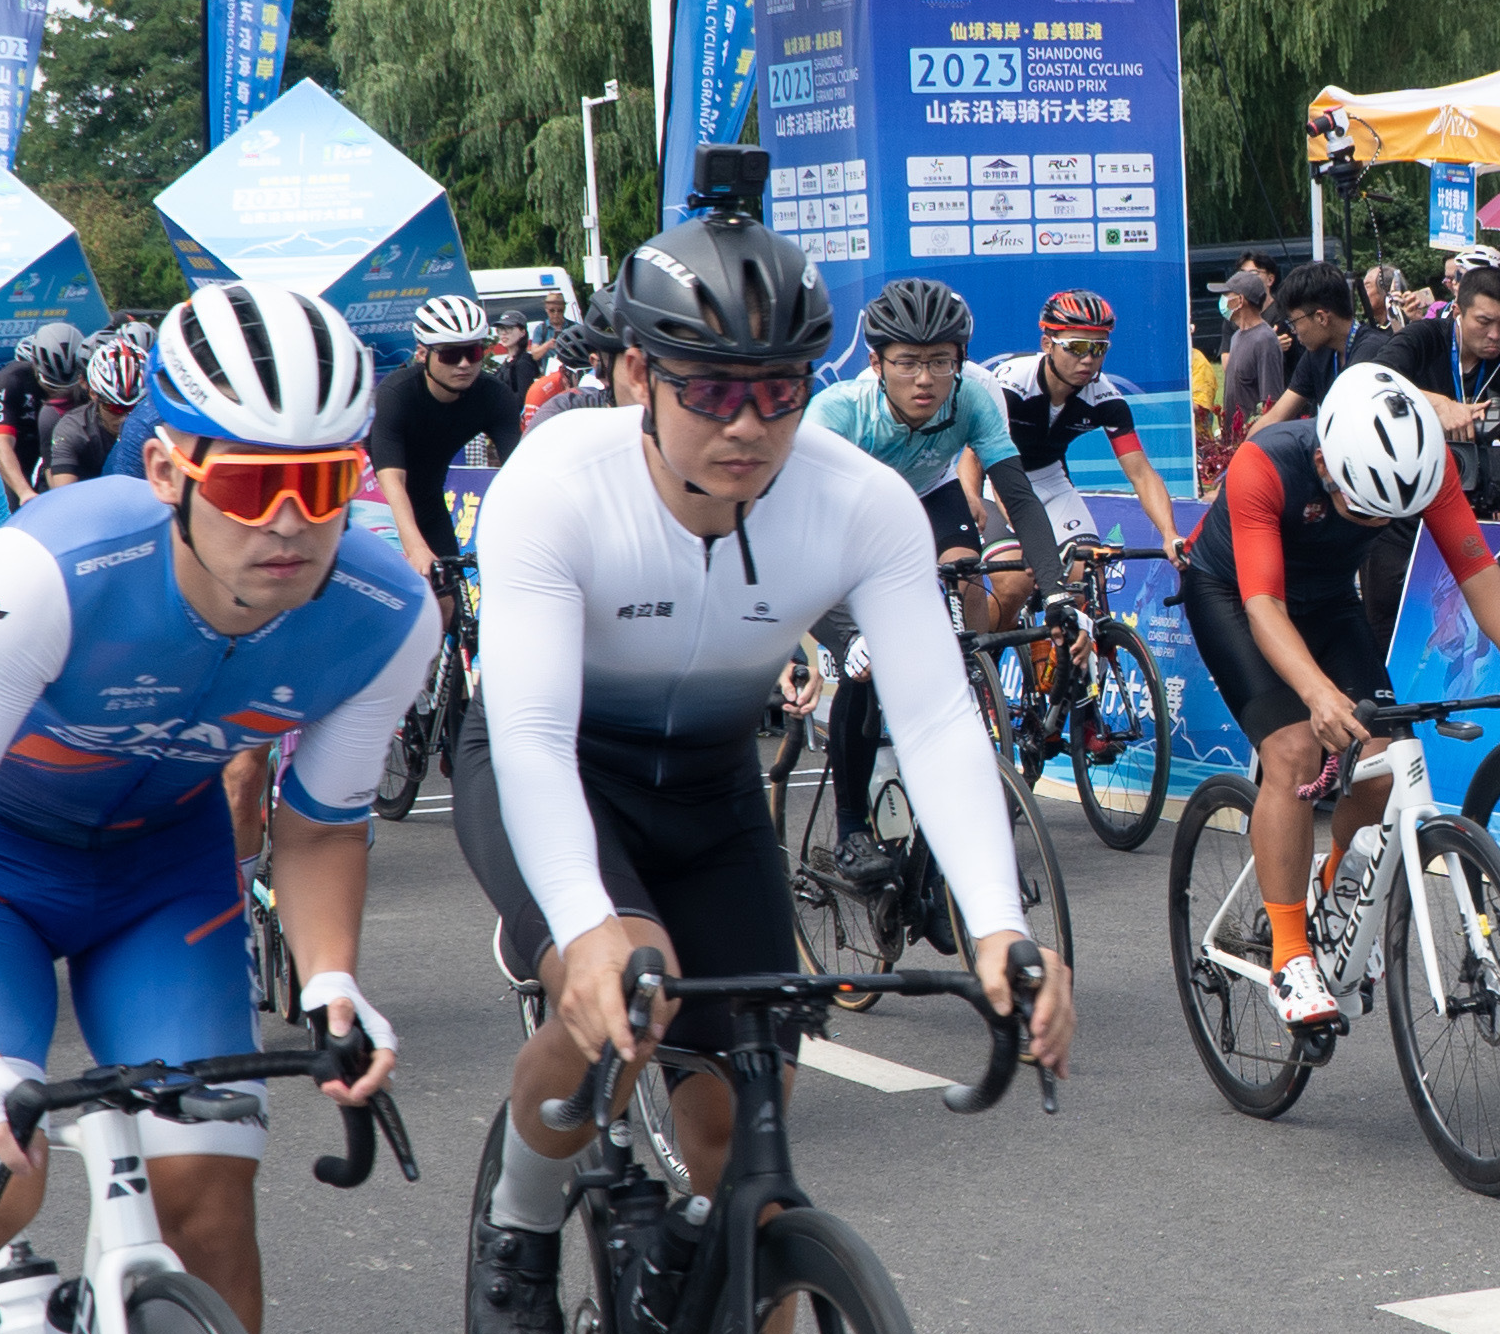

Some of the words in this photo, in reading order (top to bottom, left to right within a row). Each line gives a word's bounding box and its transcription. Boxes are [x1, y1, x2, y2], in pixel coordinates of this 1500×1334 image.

[949, 21, 1104, 41] 仙境海岸·最美银滩
[701, 14, 718, 75] CYCLING
[1027, 46, 1103, 61] SHANDONG
[916, 53, 1018, 88] 2023
[1028, 63, 1086, 77] COASTAL
[1088, 63, 1144, 77] CYCLING
[771, 66, 812, 103] 2023
[1028, 79, 1075, 93] GRAND
[1077, 79, 1108, 93] PRIX
[776, 105, 856, 137] 山东沿海骑行大奖赛
[925, 98, 1132, 125] 山东沿海骑行大奖赛
[1097, 164, 1152, 173] TESLA
[1436, 187, 1469, 212] 计时裁判
[1440, 210, 1466, 234] 工作区
[1150, 616, 1179, 628] SHANDONG
[1147, 630, 1170, 643] COASTAL
[1170, 633, 1192, 645] CYCLING
